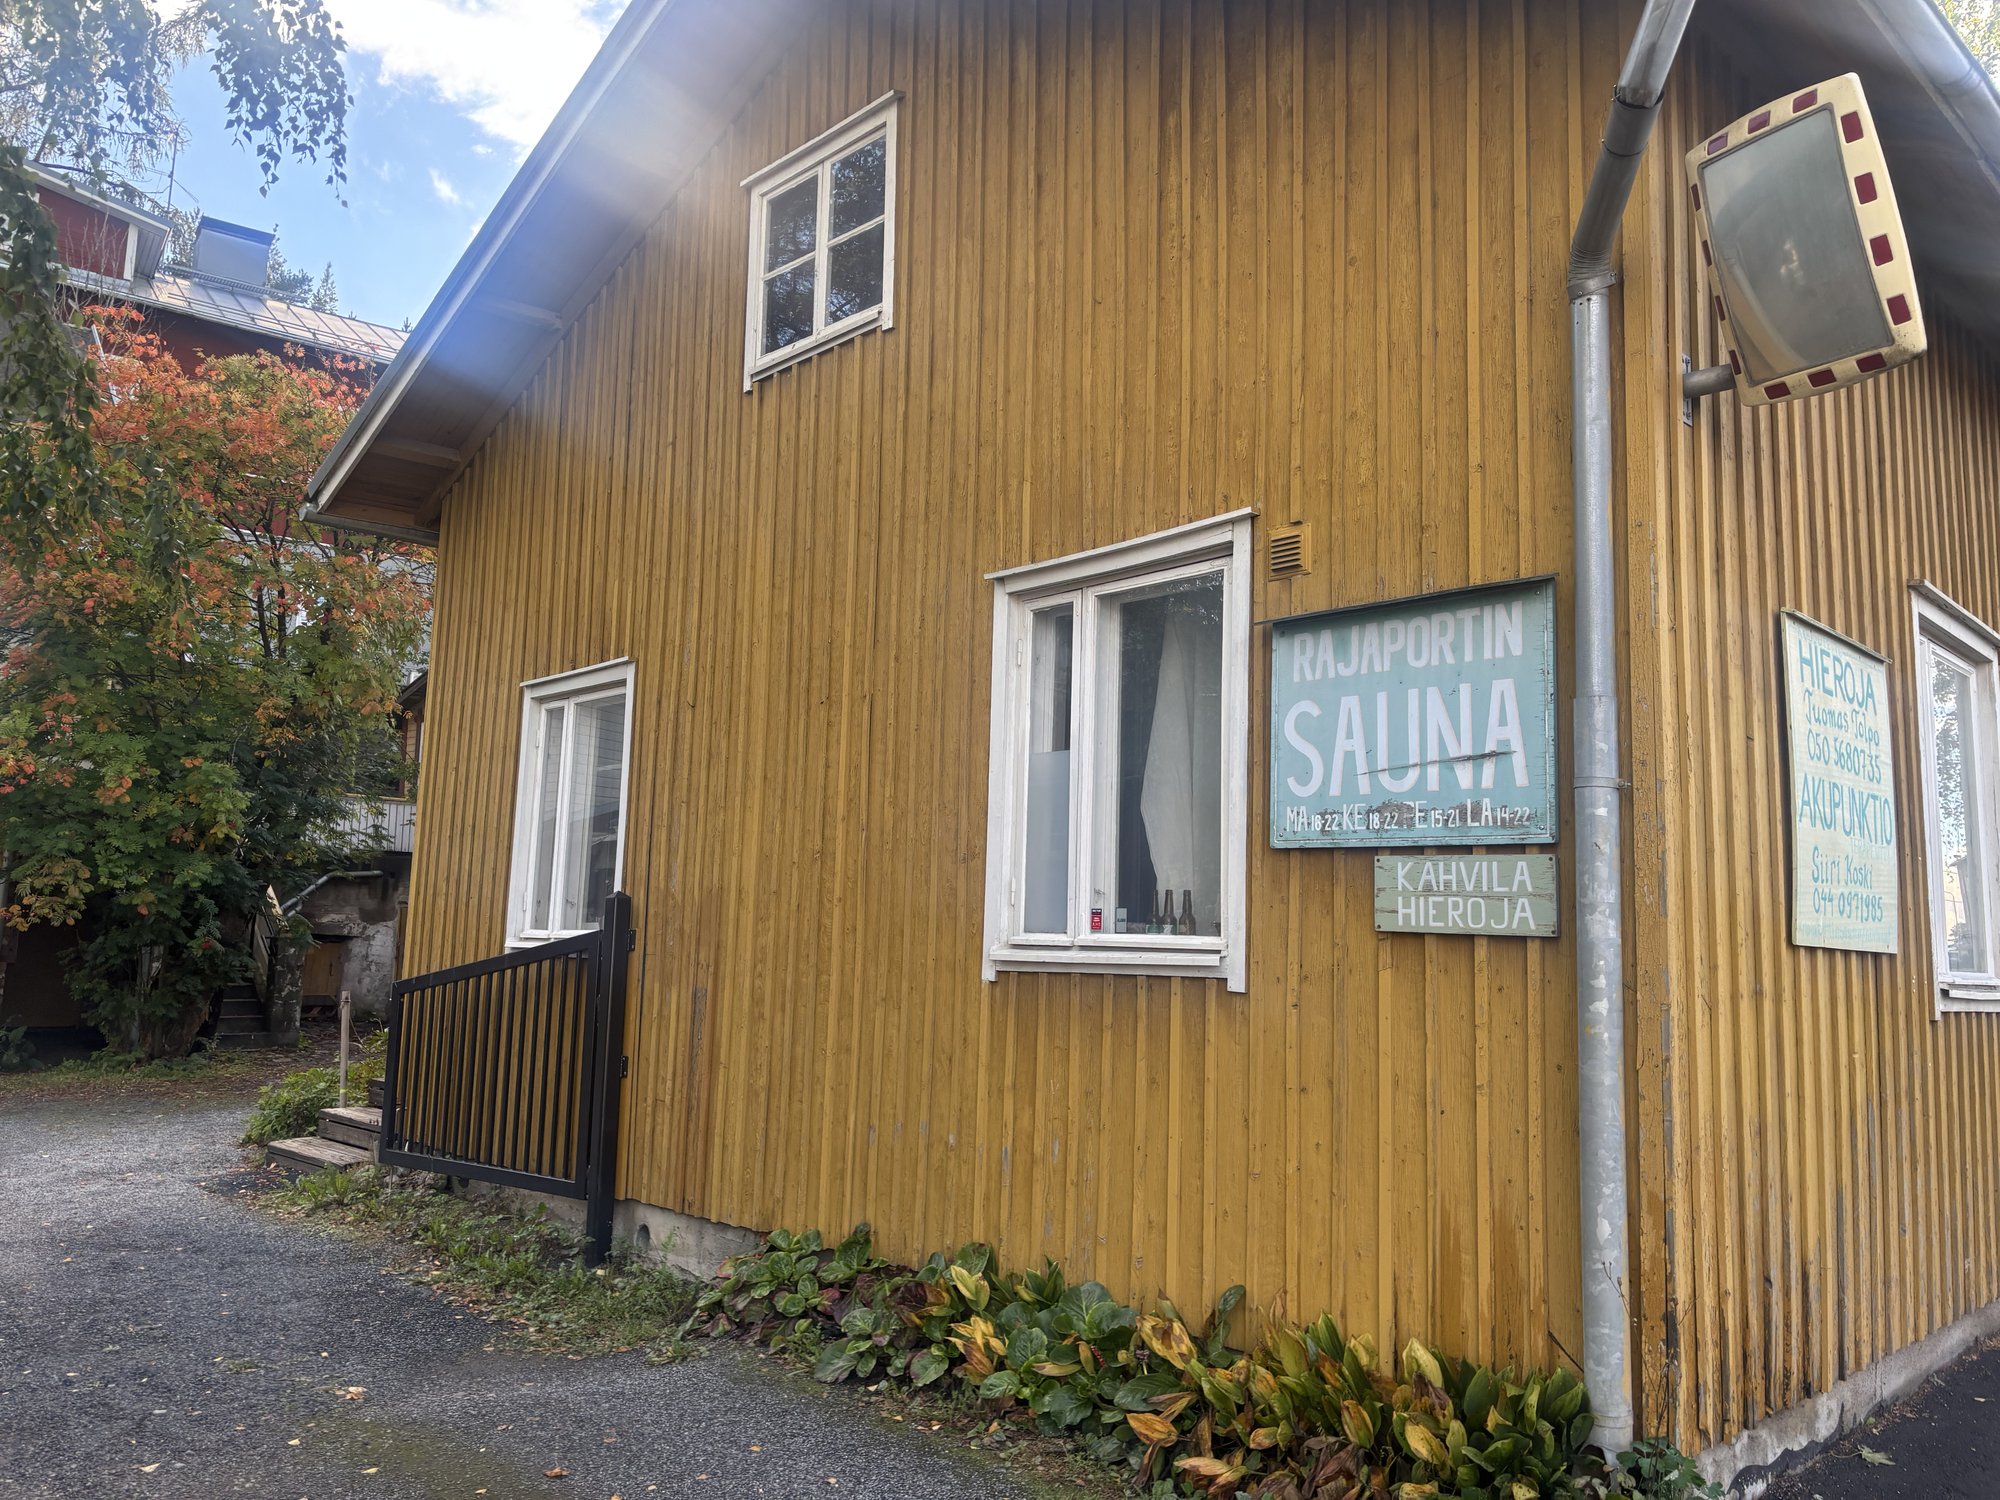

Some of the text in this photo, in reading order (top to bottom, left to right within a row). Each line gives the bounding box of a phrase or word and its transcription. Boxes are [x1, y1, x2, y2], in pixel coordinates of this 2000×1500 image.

[1293, 600, 1523, 683] RAJAPORTIN
[1798, 639, 1877, 716] HIEROJA
[1803, 687, 1849, 732] Tuomas
[1284, 678, 1530, 797] SAUNA
[1807, 728, 1881, 784] 050 5680735
[1286, 805, 1308, 831] MA
[1343, 803, 1367, 830] KE
[1431, 809, 1460, 828] 15-21
[1467, 798, 1493, 826] LA
[1497, 806, 1530, 826] 14-22
[1799, 772, 1892, 845] AKUPUNKTIO
[1397, 860, 1533, 893] KAHVILA
[1811, 846, 1840, 886] Siiri
[1844, 855, 1873, 890] Koski
[1397, 896, 1536, 930] HIEROJA
[1813, 887, 1883, 924] 044 0971985
